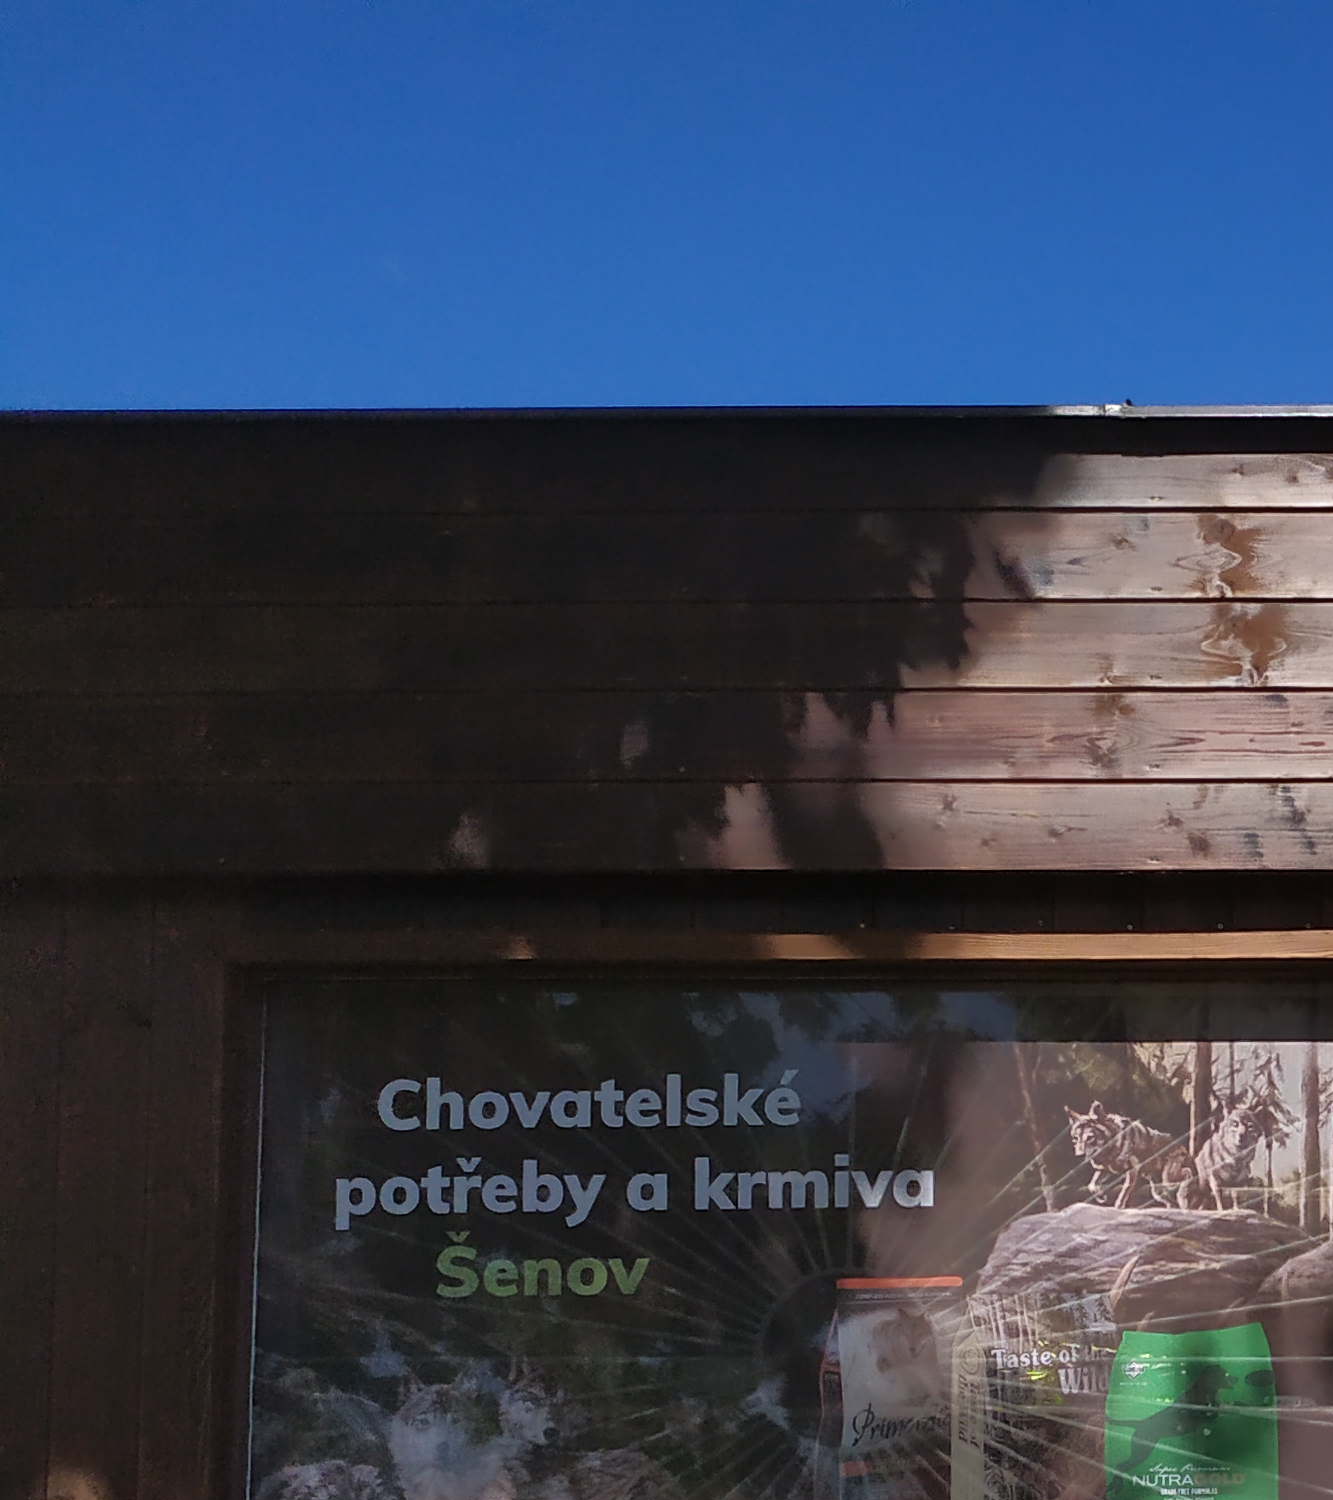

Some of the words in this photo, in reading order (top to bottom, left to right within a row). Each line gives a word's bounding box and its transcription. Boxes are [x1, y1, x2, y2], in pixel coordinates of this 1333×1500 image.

[377, 1070, 801, 1131] Chovatelské
[335, 1156, 606, 1231] potřeby
[626, 1173, 668, 1211] a
[694, 1153, 935, 1210] krmiva
[436, 1231, 650, 1299] Šenov
[991, 1348, 1052, 1370] Taste
